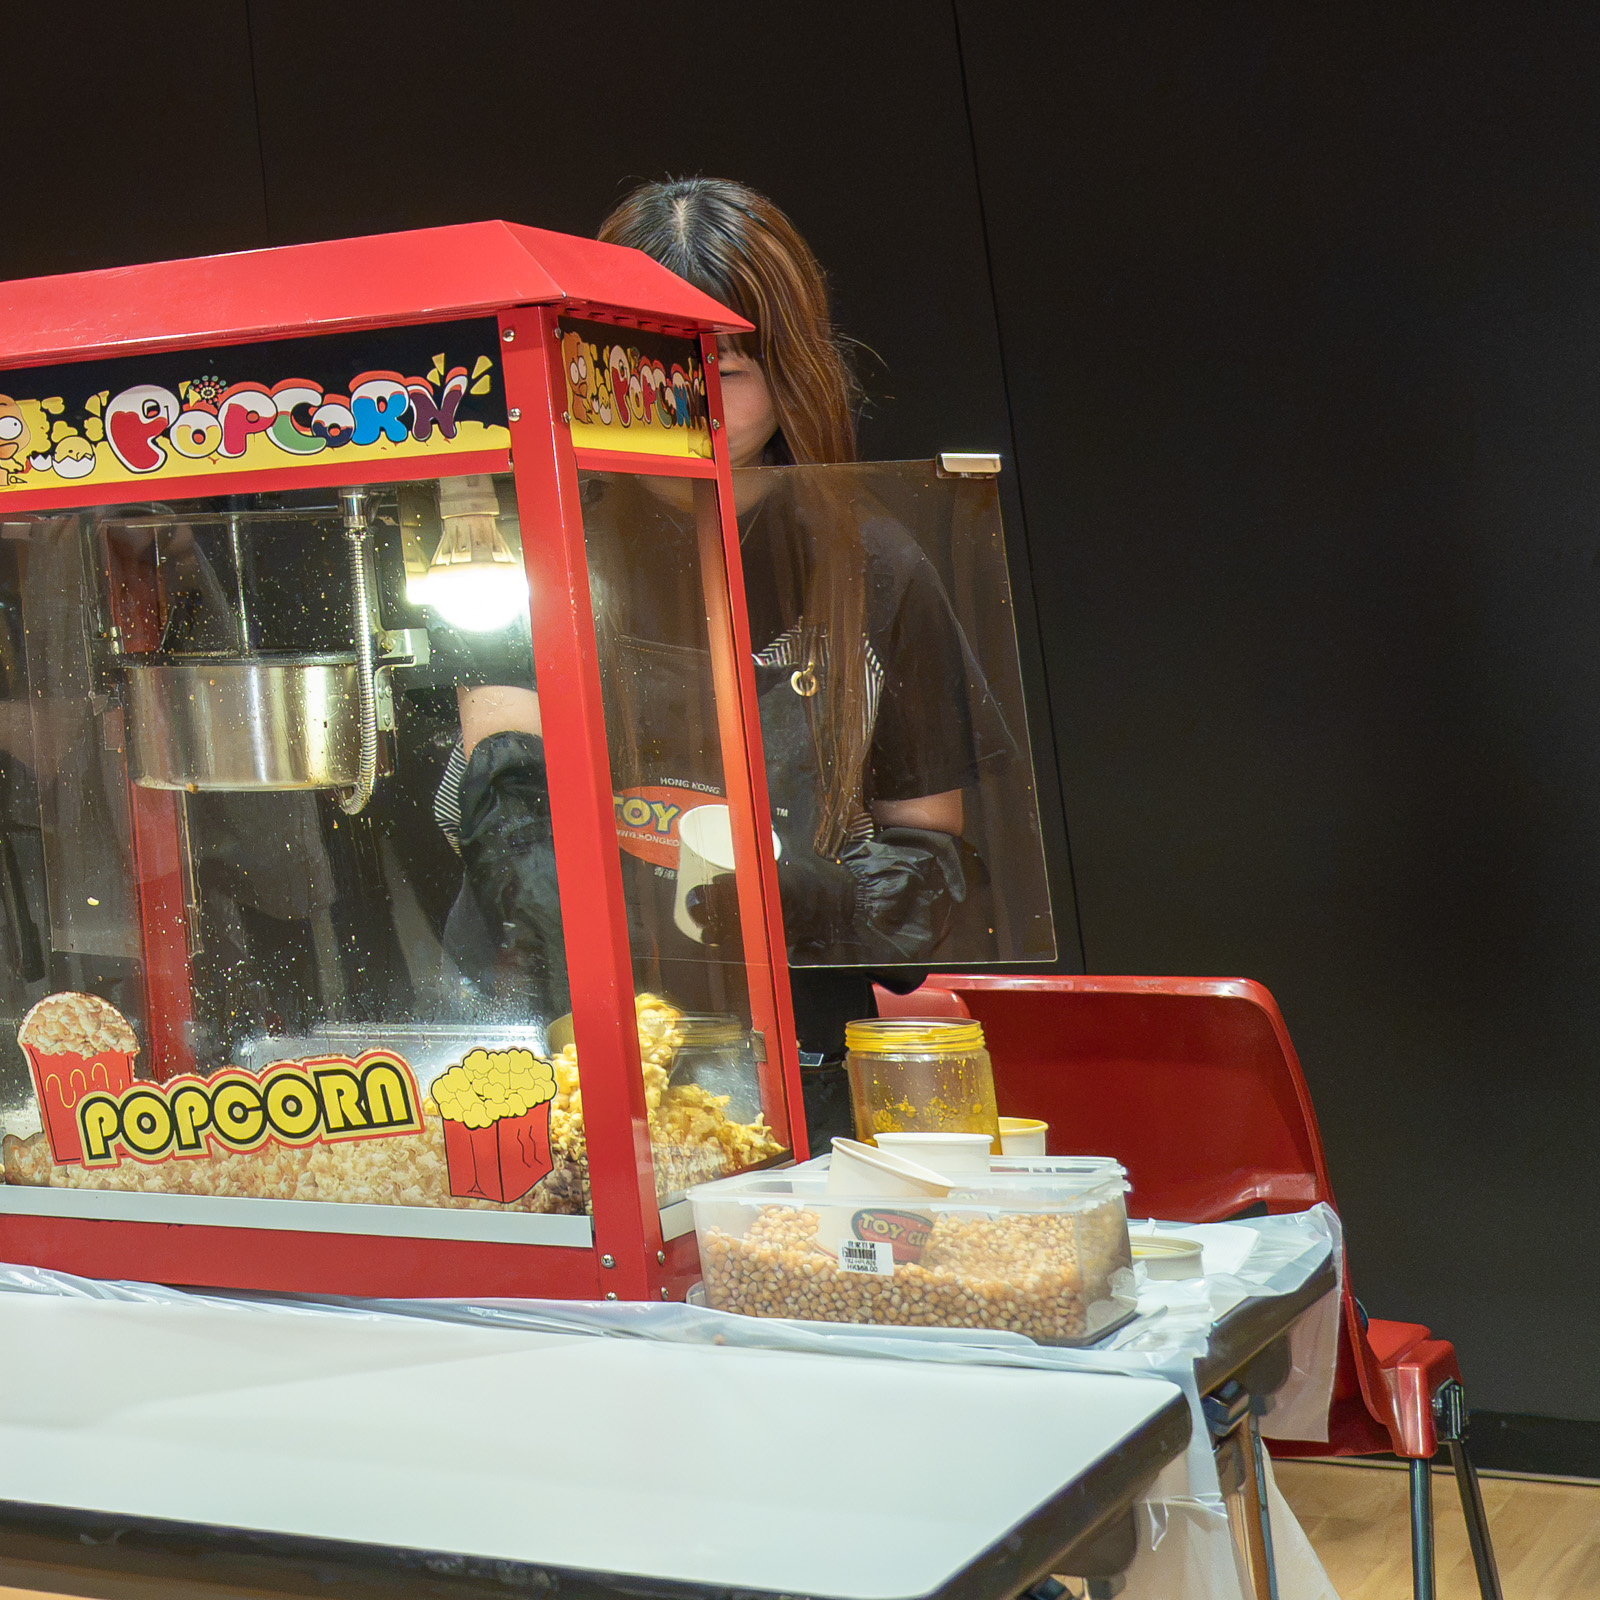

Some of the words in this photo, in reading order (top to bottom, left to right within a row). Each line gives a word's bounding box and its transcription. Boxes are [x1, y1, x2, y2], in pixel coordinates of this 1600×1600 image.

[660, 777, 690, 788] HONG
[691, 782, 721, 794] KONG
[776, 807, 789, 817] TM
[81, 1061, 414, 1161] POPCORN
[861, 1213, 905, 1240] TOY
